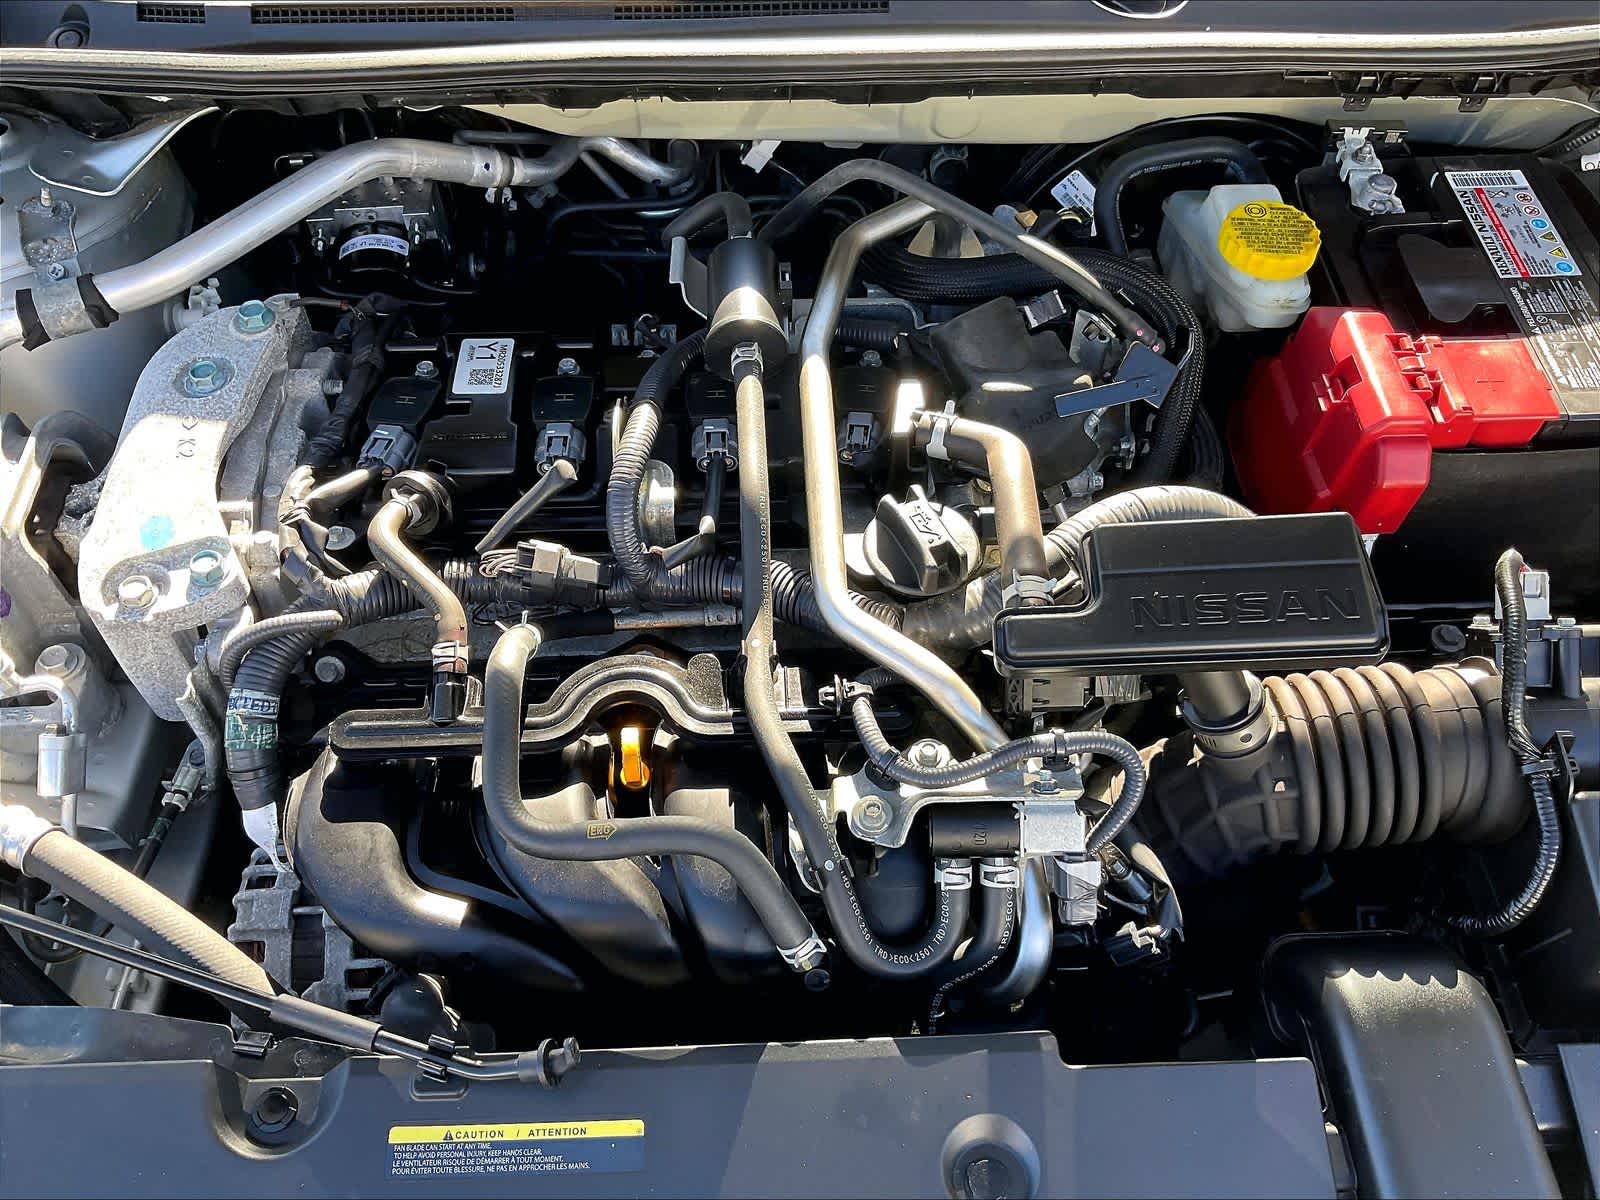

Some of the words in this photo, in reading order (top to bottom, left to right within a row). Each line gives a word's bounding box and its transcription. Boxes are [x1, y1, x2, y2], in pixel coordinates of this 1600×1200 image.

[1457, 190, 1489, 232] NISSAN
[1481, 235, 1513, 276] RENAULT
[476, 341, 499, 360] Y1
[1129, 588, 1360, 629] NISSAN
[455, 1130, 504, 1139] CAUTION
[528, 1127, 587, 1137] ATTENTION
[401, 1159, 442, 1167] VENTILATEUR
[442, 1158, 465, 1167] RISQUE
[475, 1156, 510, 1165] DÉMARRER
[534, 1155, 564, 1163] MOMENT.
[418, 1151, 436, 1159] AVOID
[437, 1150, 466, 1158] PERSONAL
[488, 1149, 502, 1157] KEEP
[392, 1167, 410, 1175] POUR
[411, 1166, 432, 1175] ÉVITER
[497, 1164, 508, 1172] PAS
[508, 1164, 518, 1172] EN
[518, 1162, 556, 1171] APPROCHER
[568, 1161, 590, 1169] MAINS.
